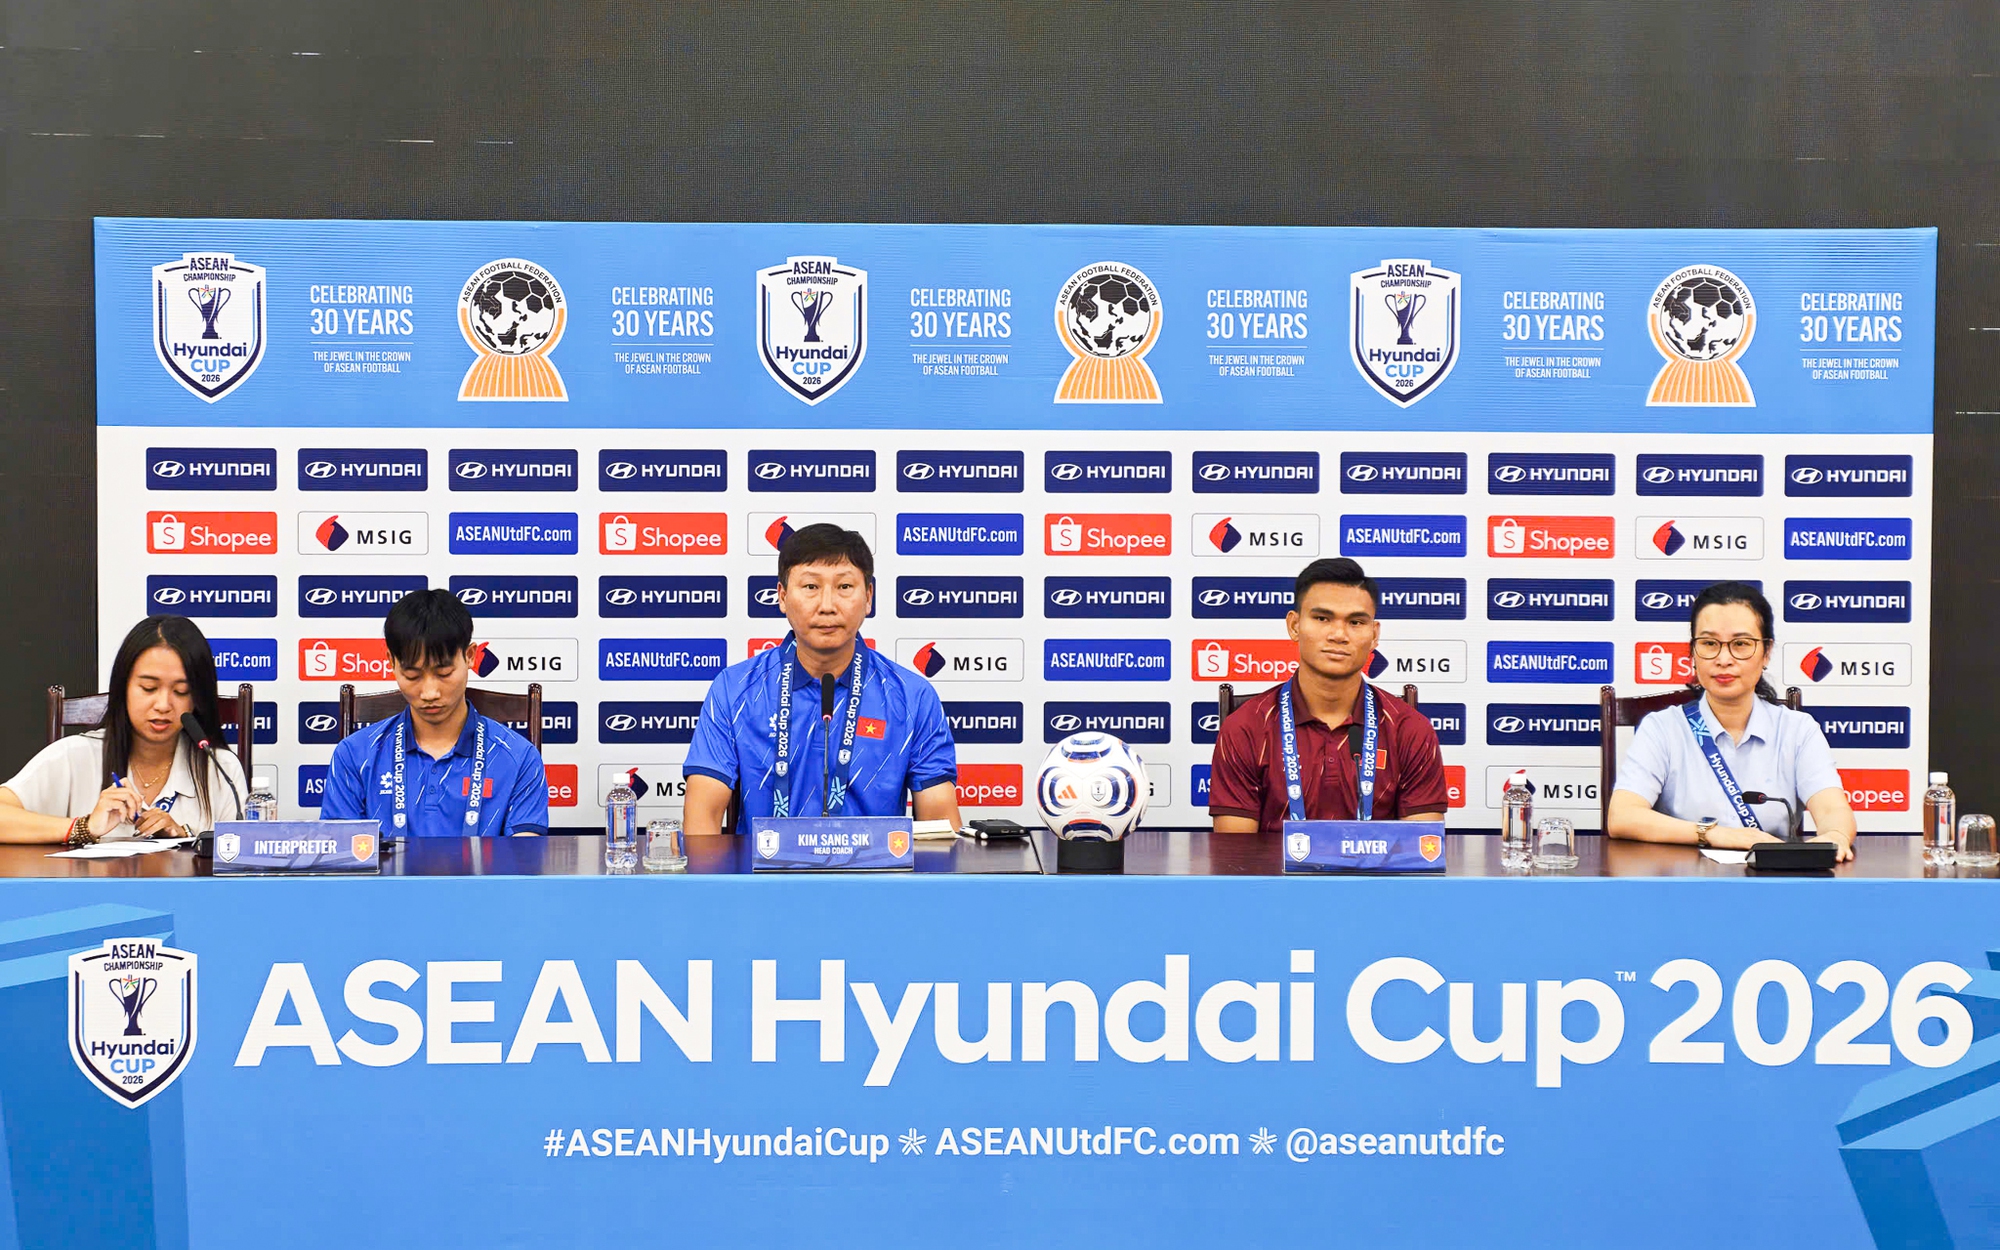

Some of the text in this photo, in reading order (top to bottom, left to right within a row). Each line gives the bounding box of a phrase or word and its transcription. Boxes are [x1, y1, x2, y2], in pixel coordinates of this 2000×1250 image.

[189, 257, 229, 271] ASEAN
[793, 261, 831, 275] ASEAN
[1387, 264, 1425, 278] ASEAN
[183, 273, 236, 282] CHAMPIONSHIP
[462, 262, 563, 304] ASEAN FOOTBALL FEDERATION
[786, 277, 838, 286] CHAMPIONSHIP
[1380, 279, 1432, 288] CHAMPIONSHIP
[1059, 265, 1159, 306] ASEAN FOOTBALL FEDERATION
[1653, 268, 1752, 309] ASEAN FOOTBALL FEDERATION
[310, 285, 412, 304] CELEBRATING
[612, 287, 713, 305] CELEBRATING
[911, 288, 1011, 307] CELEBRATING
[1207, 290, 1307, 308] CELEBRATING
[1504, 291, 1604, 310] CELEBRATING
[1801, 293, 1902, 311] CELEBRATING
[311, 309, 413, 335] 30 YEARS
[612, 310, 713, 336] 30 YEARS
[911, 312, 1011, 338] 30 YEARS
[1207, 313, 1307, 339] 30 YEARS
[1503, 314, 1604, 341] 30 YEARS
[1800, 316, 1902, 342] 30 YEARS
[174, 342, 247, 359] Hyundai
[313, 351, 411, 361] THE JEWEL IN THE CROWN
[776, 345, 848, 362] Hyundai
[1369, 348, 1440, 365] Hyundai
[190, 359, 231, 373] CUP
[912, 354, 1008, 364] THE JEWEL IN THE CROWN
[1209, 355, 1304, 365] THE JEWEL IN THE CROWN
[1802, 358, 1899, 368] THE JEWEL IN THE CROWN
[324, 363, 401, 373] OF ASEAN FOOTBALL
[792, 362, 831, 376] CUP
[923, 365, 998, 375] OF ASEAN FOOTBALL
[1219, 366, 1294, 376] OF ASEAN FOOTBALL
[1385, 364, 1424, 378] CUP
[1812, 370, 1888, 379] OF ASEAN FOOTBALL
[201, 374, 220, 383] 2026
[803, 376, 821, 385] 2026
[1395, 379, 1414, 388] 2026
[190, 463, 270, 476] HYUNDAI
[342, 464, 421, 476] HYUNDAI
[492, 464, 571, 477] HYUNDAI
[642, 465, 720, 477] HYUNDAI
[791, 465, 869, 477] HYUNDAI
[939, 465, 1017, 478] HYUNDAI
[1087, 466, 1165, 478] HYUNDAI
[1235, 466, 1313, 479] HYUNDAI
[1382, 467, 1461, 480] HYUNDAI
[1530, 468, 1609, 481] HYUNDAI
[1678, 469, 1757, 482] HYUNDAI
[1827, 470, 1906, 482] HYUNDAI
[191, 526, 271, 552] Shopee
[358, 530, 411, 544] MSIG
[456, 526, 571, 541] ASEANUtdFC.com
[642, 527, 721, 552] Shopee
[903, 527, 1017, 542] ASEANUtdFC.com
[1087, 528, 1165, 553] Shopee
[1250, 532, 1302, 546] MSIG
[1347, 528, 1460, 543] ASEANUtdFC.com
[1791, 531, 1905, 546] ASEANUtdFC.com
[1530, 530, 1609, 556] Shopee
[1694, 535, 1746, 549] MSIG
[190, 590, 270, 603] HYUNDAI
[492, 591, 571, 603] HYUNDAI
[642, 591, 720, 603] HYUNDAI
[939, 591, 1017, 603] HYUNDAI
[1087, 591, 1164, 604] HYUNDAI
[1382, 592, 1460, 605] HYUNDAI
[1529, 594, 1608, 606] HYUNDAI
[1826, 596, 1905, 608] HYUNDAI
[508, 657, 561, 670] MSIG
[606, 652, 721, 667] ASEANUtdFC.com
[954, 657, 1006, 671] MSIG
[1051, 653, 1164, 667] ASEANUtdFC.com
[1397, 658, 1449, 672] MSIG
[1494, 654, 1607, 670] ASEANUtdFC.com
[1841, 662, 1894, 676] MSIG
[843, 653, 863, 746] Hyundai Cup 2026
[778, 662, 793, 757] Hyundai Cup 2026
[1086, 717, 1164, 729] HYUNDAI
[1825, 721, 1904, 734] HYUNDAI
[1280, 691, 1299, 780] Hyundai Cup 2026
[394, 722, 405, 809] Hyundai Cup 2026
[470, 722, 485, 808] Hyundai Cup 2026
[1709, 752, 1740, 796] Hyundai
[1544, 785, 1597, 799] MSIG
[798, 833, 870, 847] KIM SANG SIK
[254, 840, 338, 855] INTERPRETER
[814, 847, 853, 855] HEAD COACH
[1341, 840, 1388, 855] PLAYER
[111, 944, 156, 960] ASEAN
[104, 961, 164, 972] CHAMPIONSHIP
[235, 960, 713, 1066] ASEAN
[752, 950, 1314, 1086] Hyundai
[1649, 959, 1973, 1068] 2026
[91, 1039, 175, 1059] Hyundai
[110, 1058, 156, 1074] CUP
[122, 1075, 144, 1085] 2026
[544, 1126, 1504, 1163] #ASEANHyundaiCup ASEANUtdFC.com @aseanutdfc
